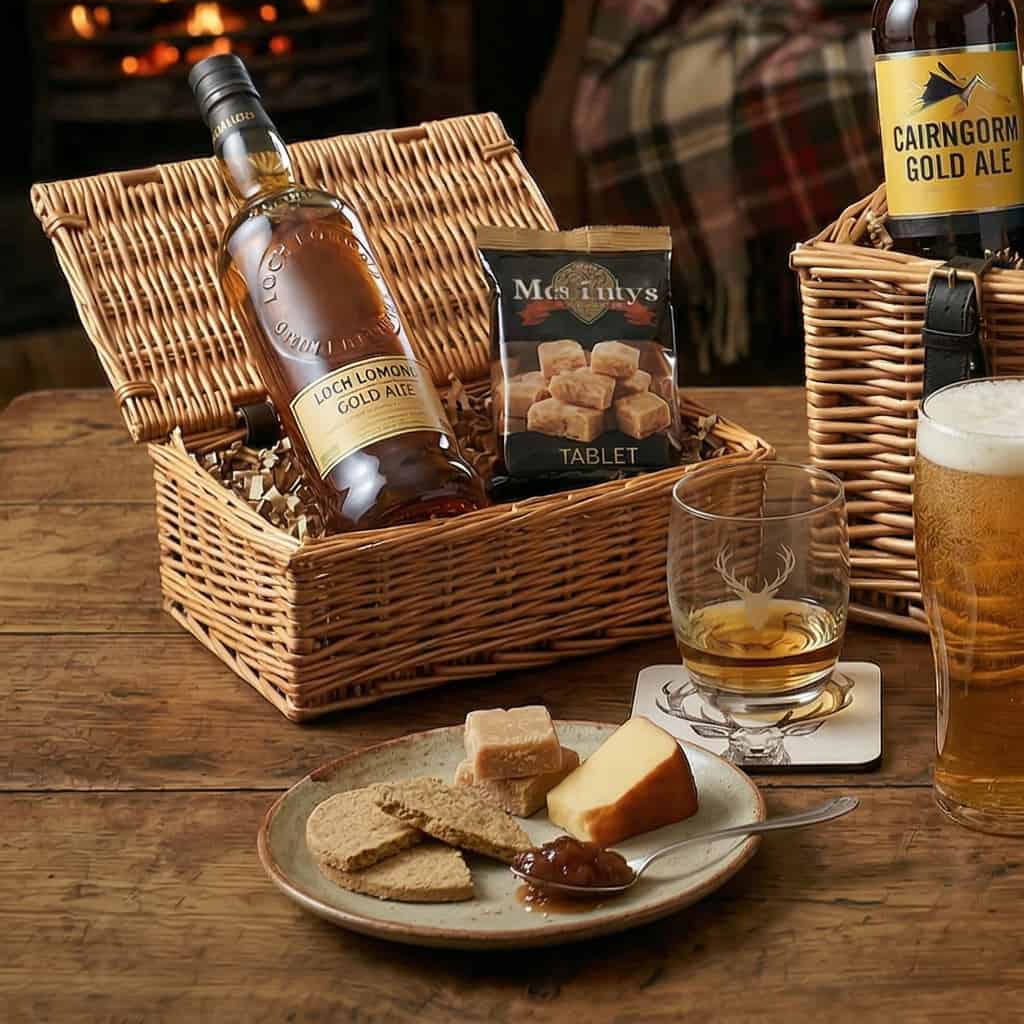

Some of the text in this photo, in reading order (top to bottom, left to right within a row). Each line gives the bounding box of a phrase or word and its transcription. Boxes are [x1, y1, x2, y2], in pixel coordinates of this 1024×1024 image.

[893, 115, 1019, 153] CAIRNGORM
[906, 148, 1013, 182] GOLD ALE
[313, 375, 353, 406] LOCH
[337, 388, 381, 415] GOLD
[559, 447, 639, 465] TABLET
